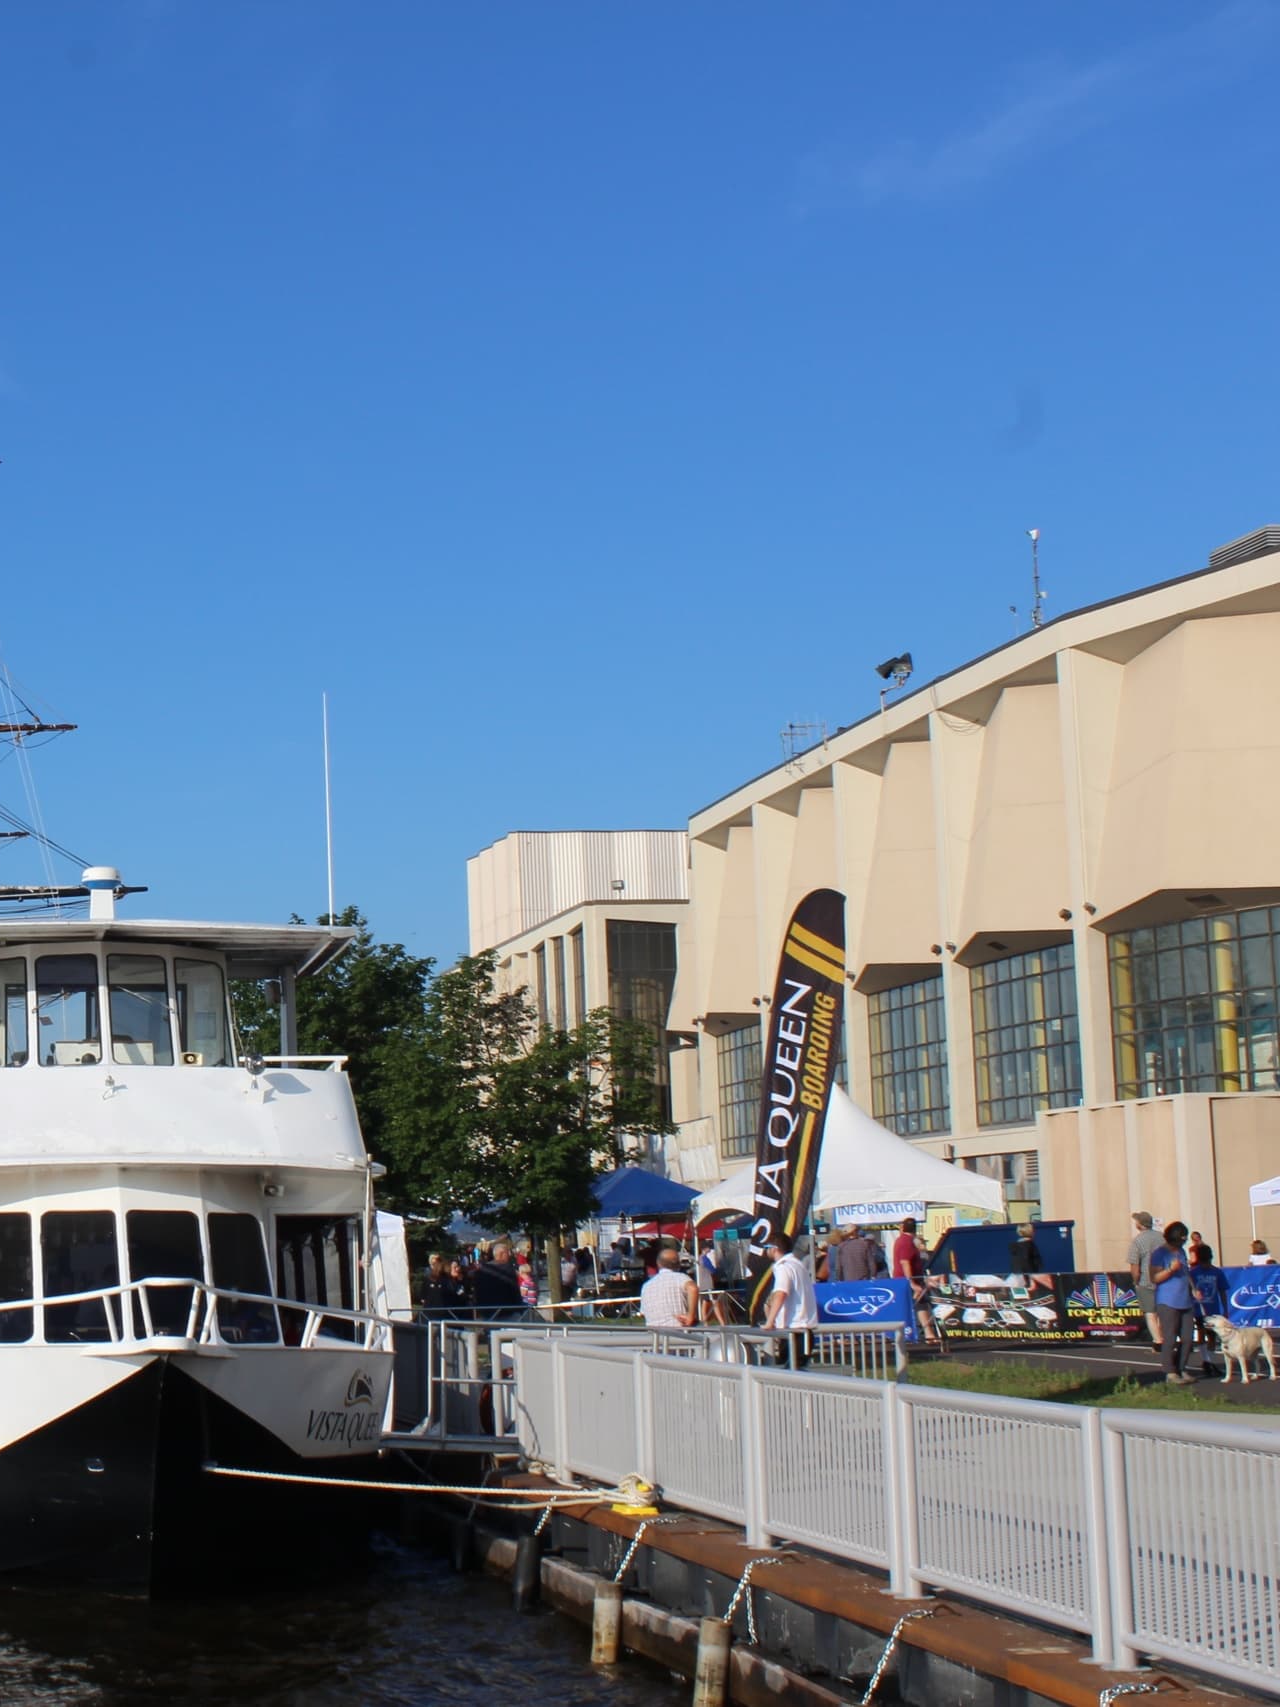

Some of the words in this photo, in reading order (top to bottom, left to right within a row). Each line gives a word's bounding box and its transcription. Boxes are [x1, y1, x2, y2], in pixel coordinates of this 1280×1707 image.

[767, 978, 813, 1148] QUEEN
[800, 991, 837, 1111] BOARDING
[746, 1160, 789, 1277] ISTA
[836, 1201, 924, 1217] INFORMATION
[832, 1294, 886, 1305] ALLETE
[1087, 1316, 1126, 1326] CASINO
[306, 1409, 348, 1441] VISTA
[346, 1411, 380, 1449] QUEE
